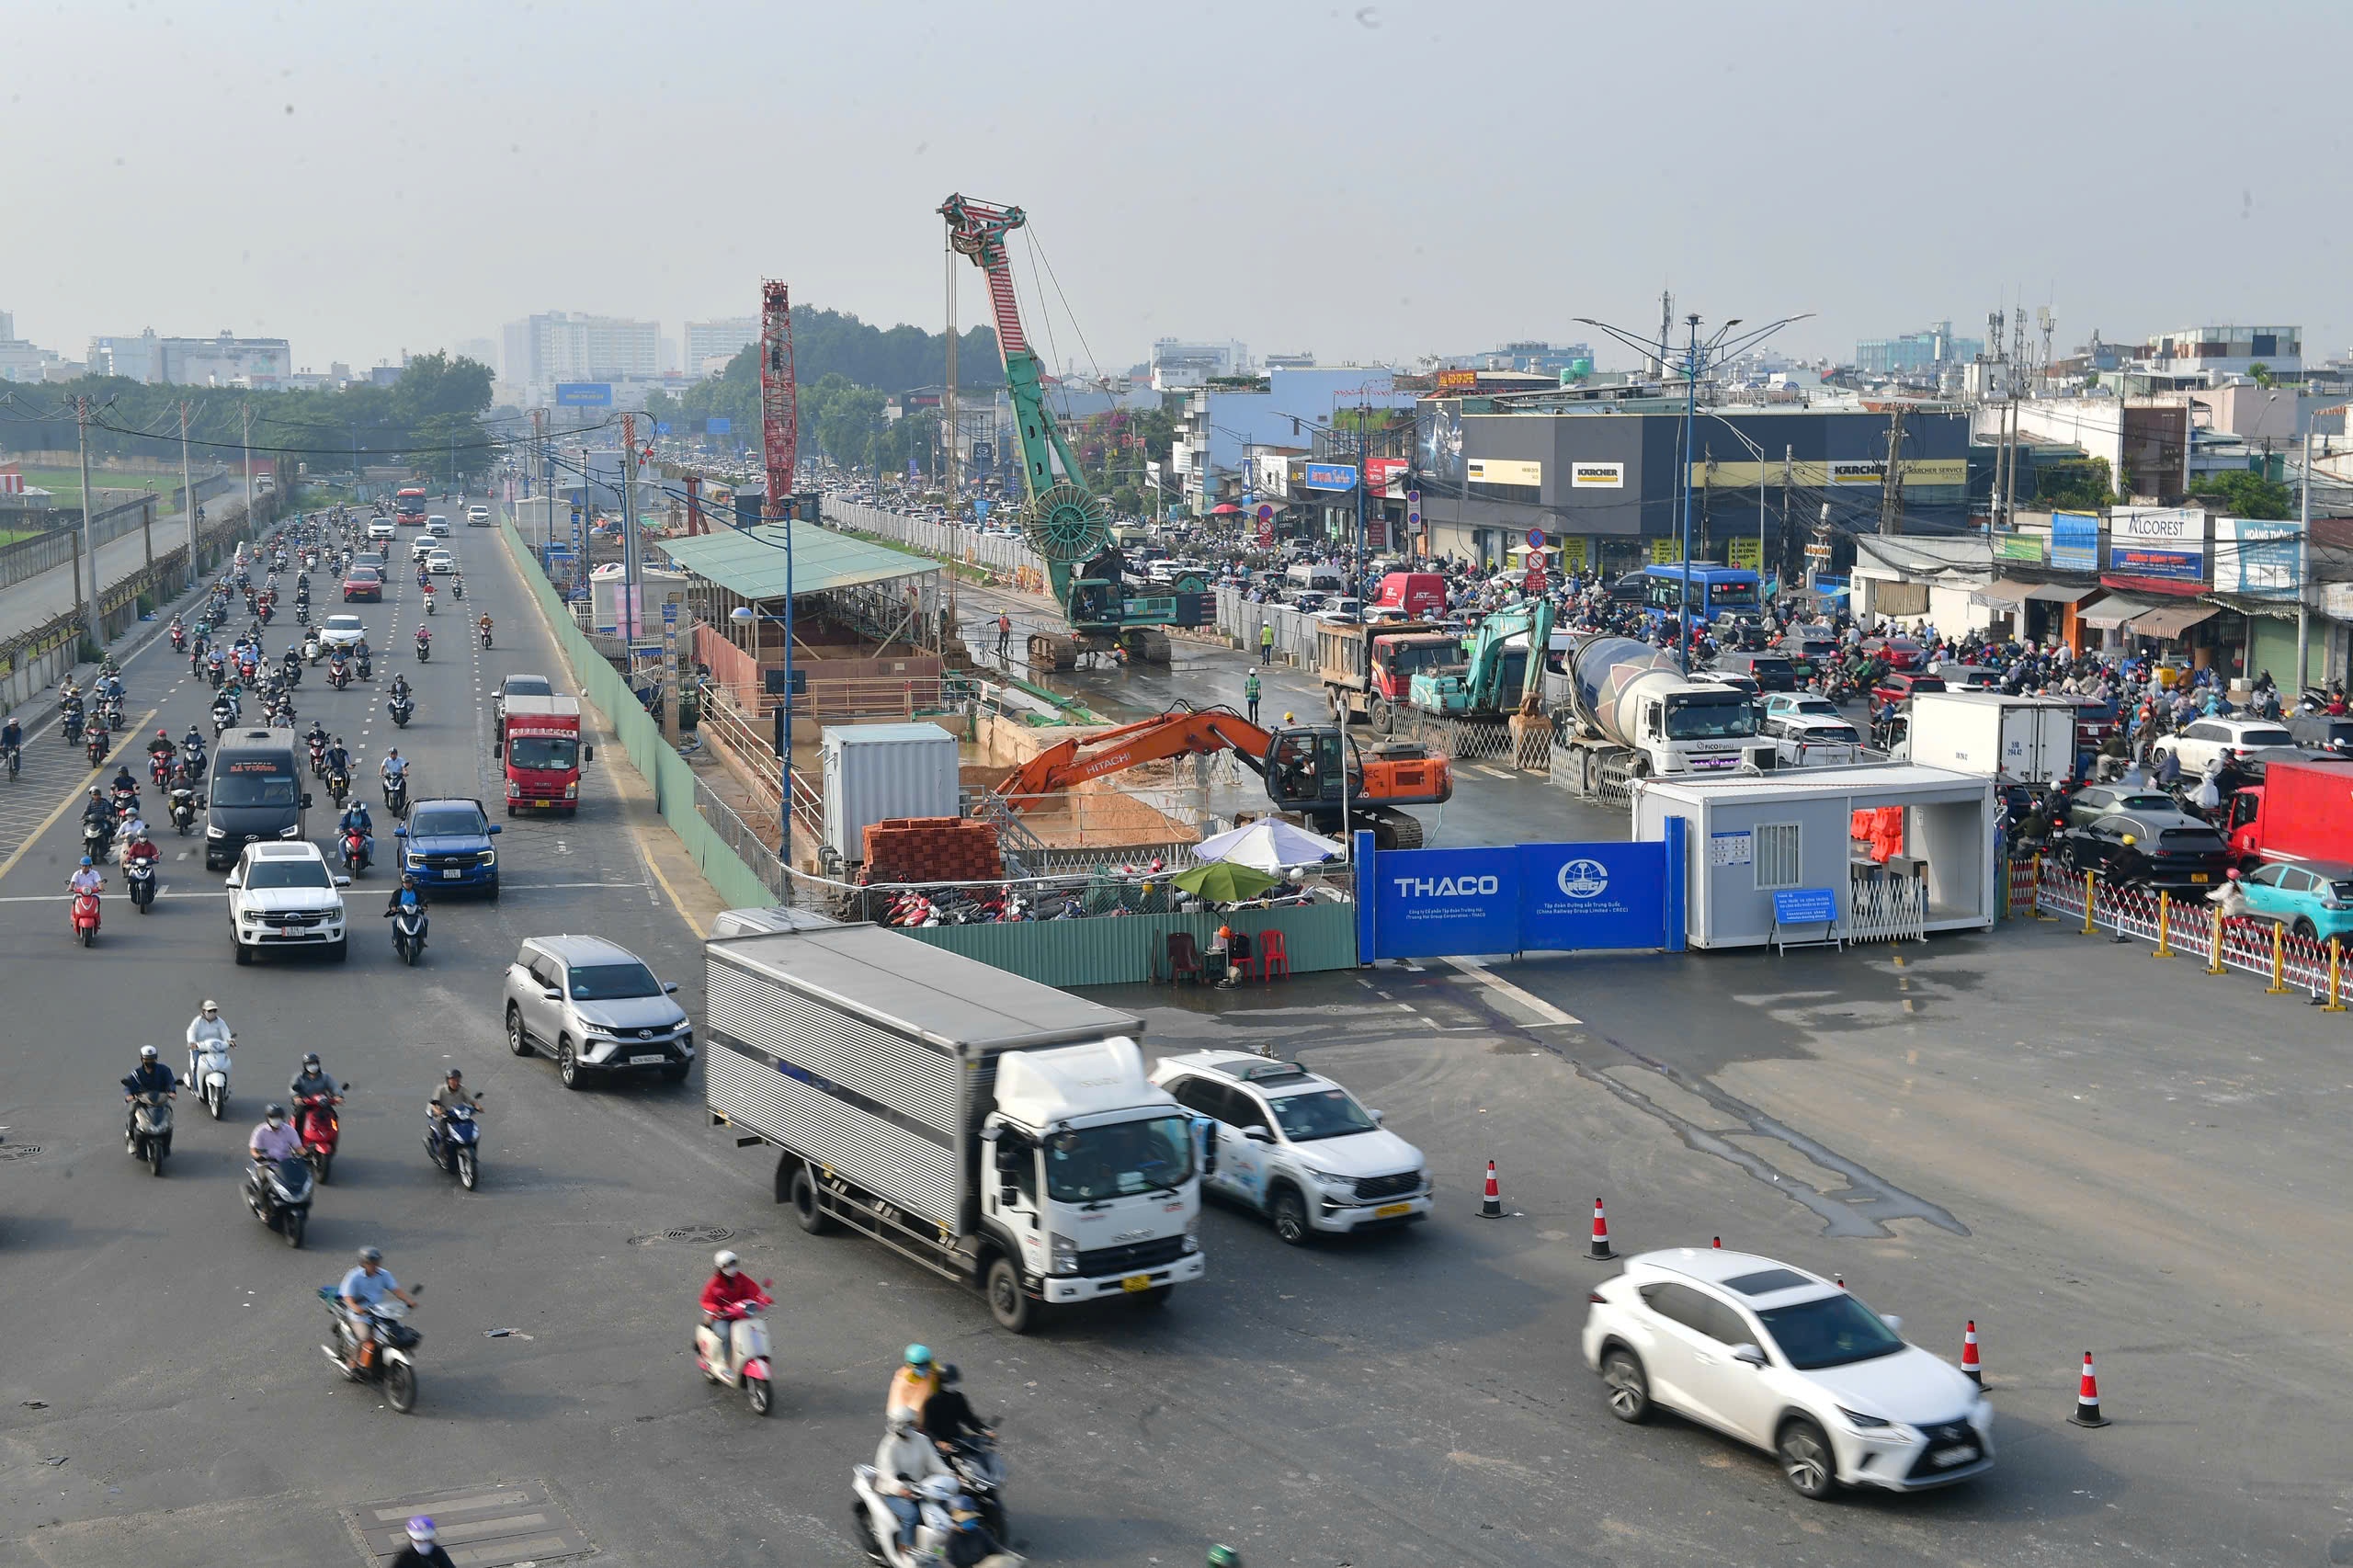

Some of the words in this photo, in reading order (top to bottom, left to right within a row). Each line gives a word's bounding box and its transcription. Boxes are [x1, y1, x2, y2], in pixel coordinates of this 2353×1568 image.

[2245, 527, 2269, 540] HOÀNG
[1086, 752, 1131, 774] HITACHI
[1394, 875, 1498, 898] THACO
